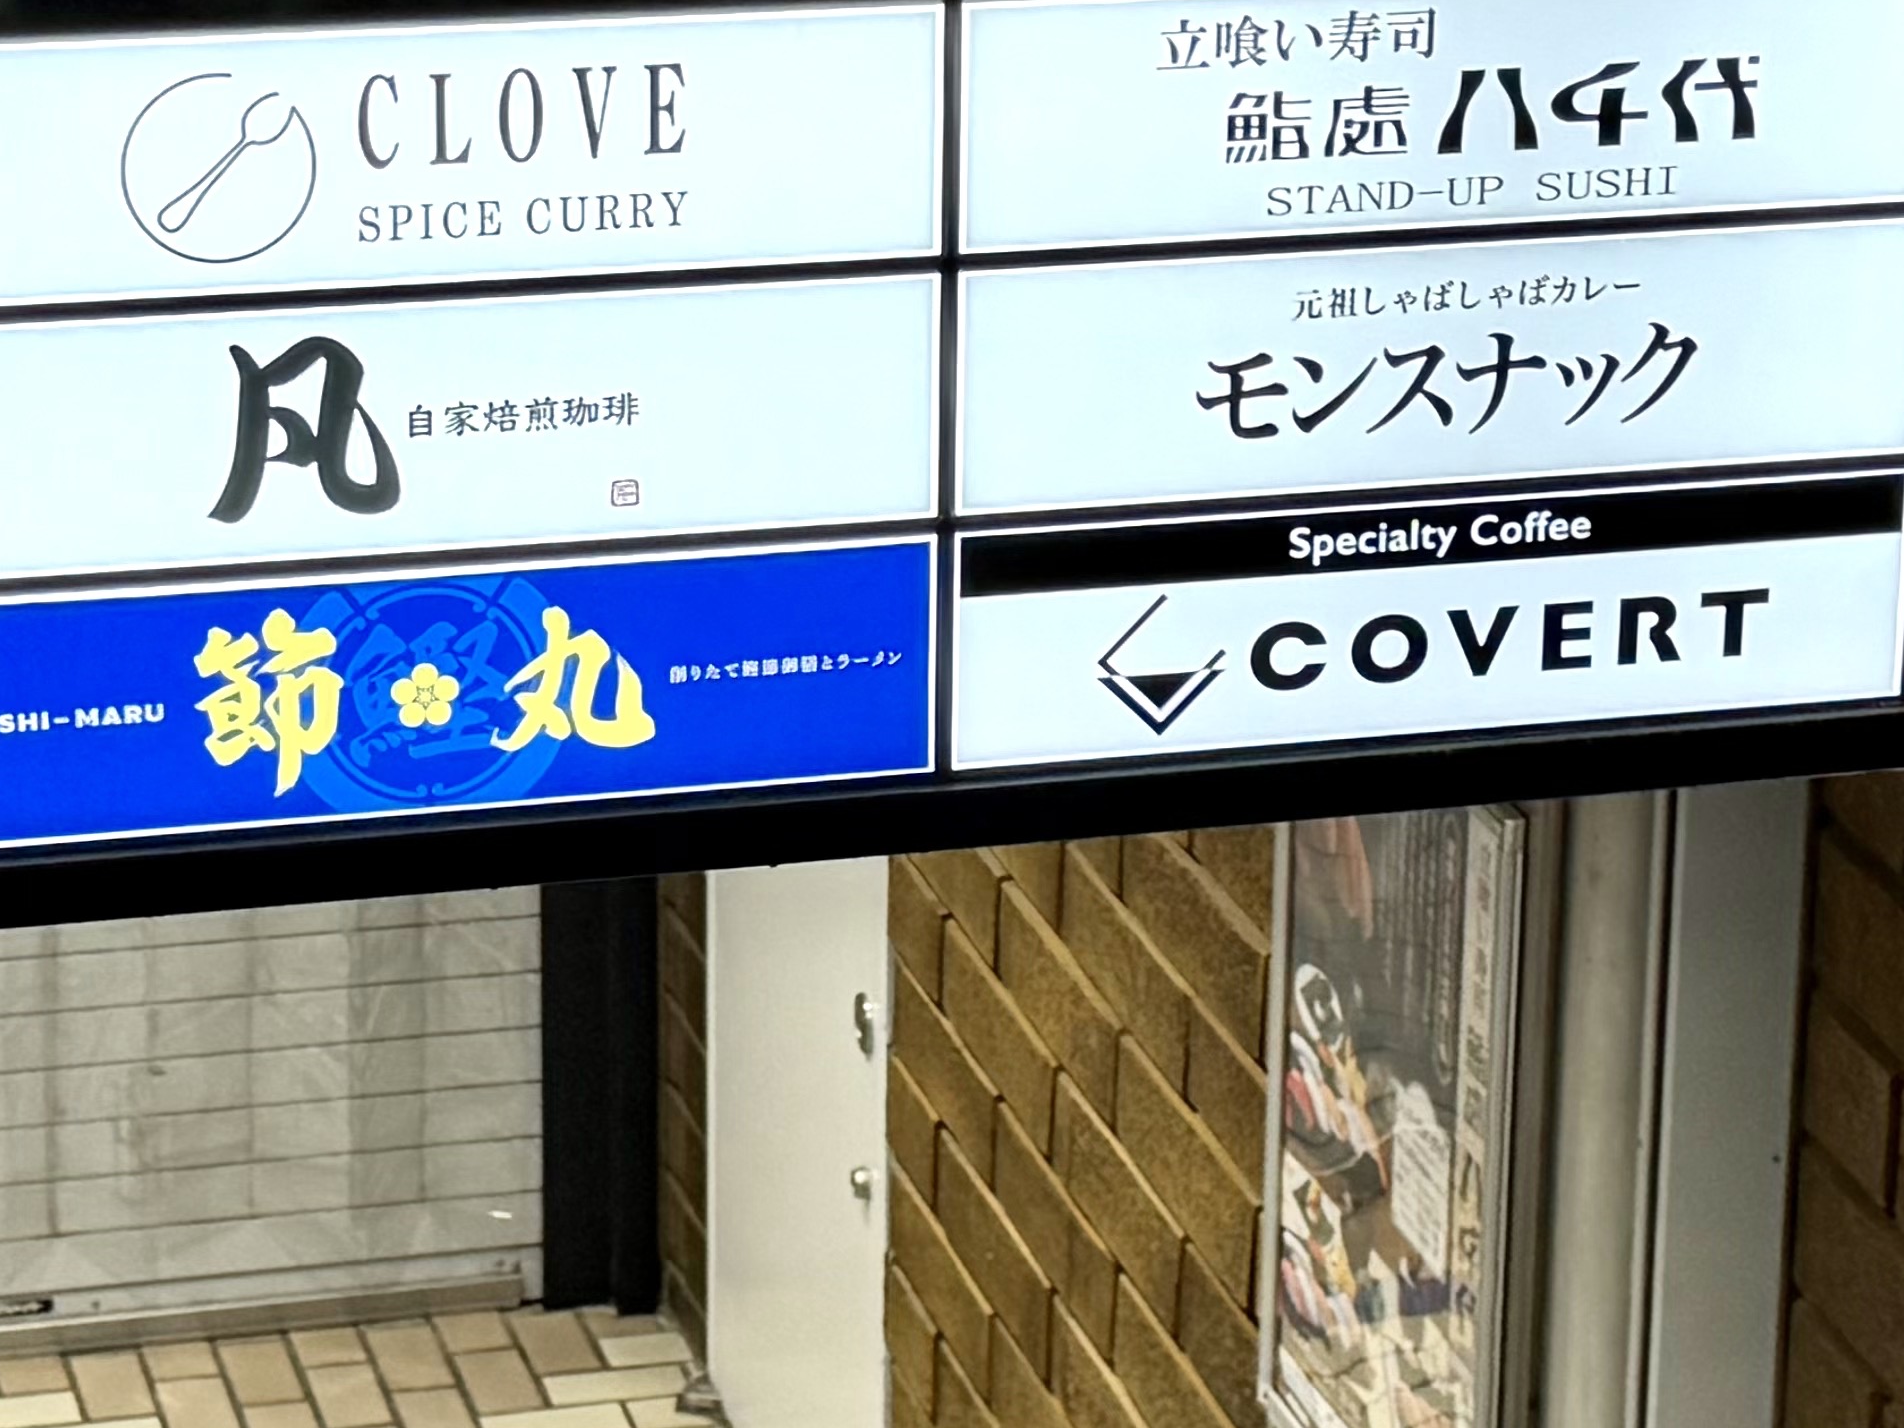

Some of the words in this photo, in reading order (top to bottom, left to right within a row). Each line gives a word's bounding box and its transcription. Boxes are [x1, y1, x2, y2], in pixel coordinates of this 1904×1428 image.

[1156, 7, 1436, 71] 立喰い寿司
[357, 62, 686, 170] CLOVE
[358, 200, 502, 243] SPICE
[526, 190, 688, 235] CURRY
[1266, 176, 1504, 216] STAND-UP
[1535, 165, 1678, 202] SUSHI
[1295, 274, 1641, 319] 元祖しゃばしゃばカレー
[1195, 322, 1698, 440] モンスナック
[408, 391, 640, 439] 自家焙煎珈琲
[1287, 518, 1457, 566] Specialty
[1469, 510, 1592, 547] Coffee
[1250, 587, 1770, 691] COVERT
